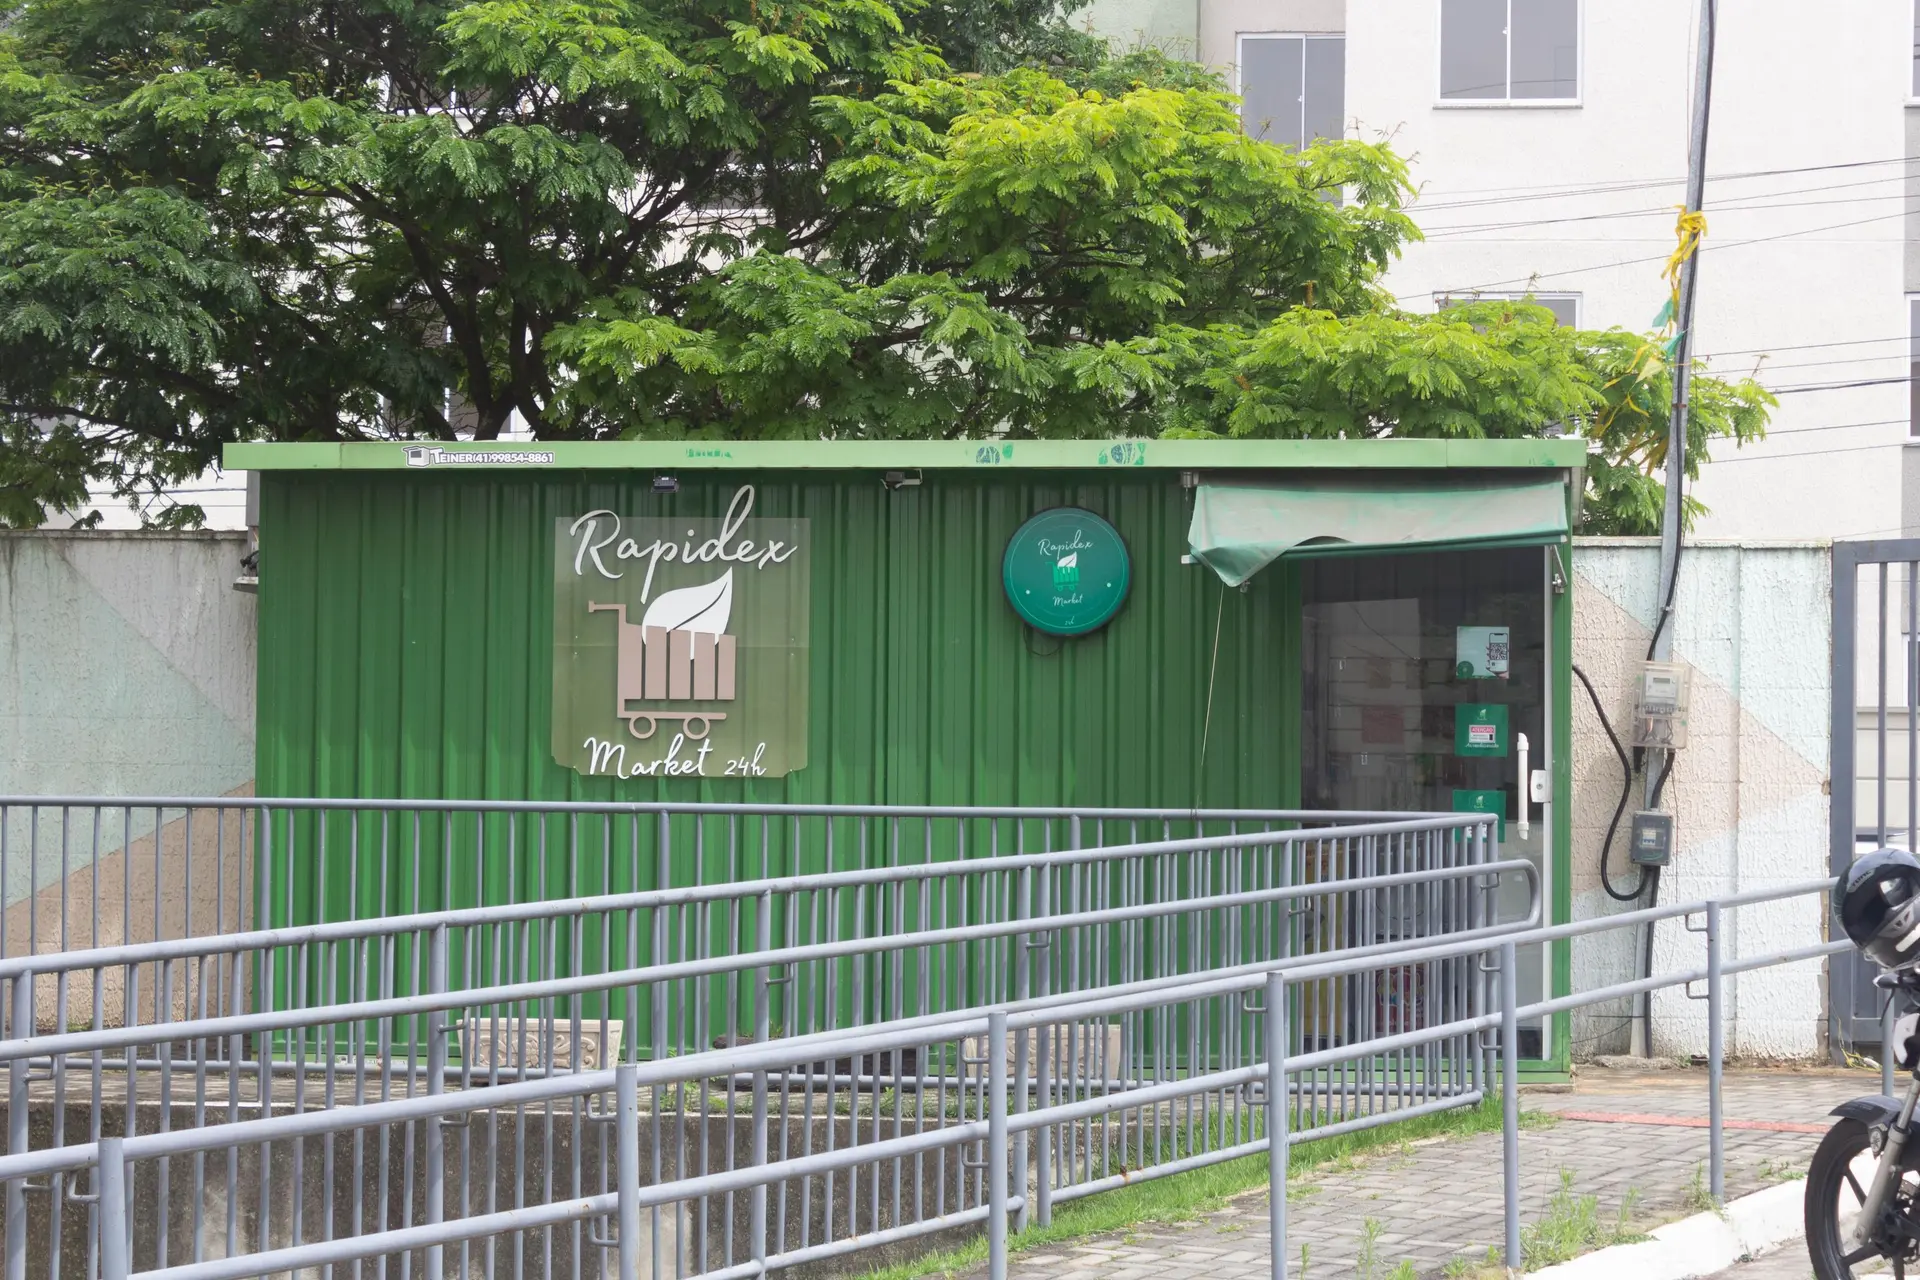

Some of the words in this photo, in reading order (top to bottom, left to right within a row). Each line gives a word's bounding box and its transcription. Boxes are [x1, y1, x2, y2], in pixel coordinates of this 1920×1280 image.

[570, 484, 798, 604] Rapidex
[1037, 529, 1093, 560] Rapidex
[1053, 593, 1083, 607] Market
[583, 733, 713, 780] Market
[724, 742, 767, 776] 24h
